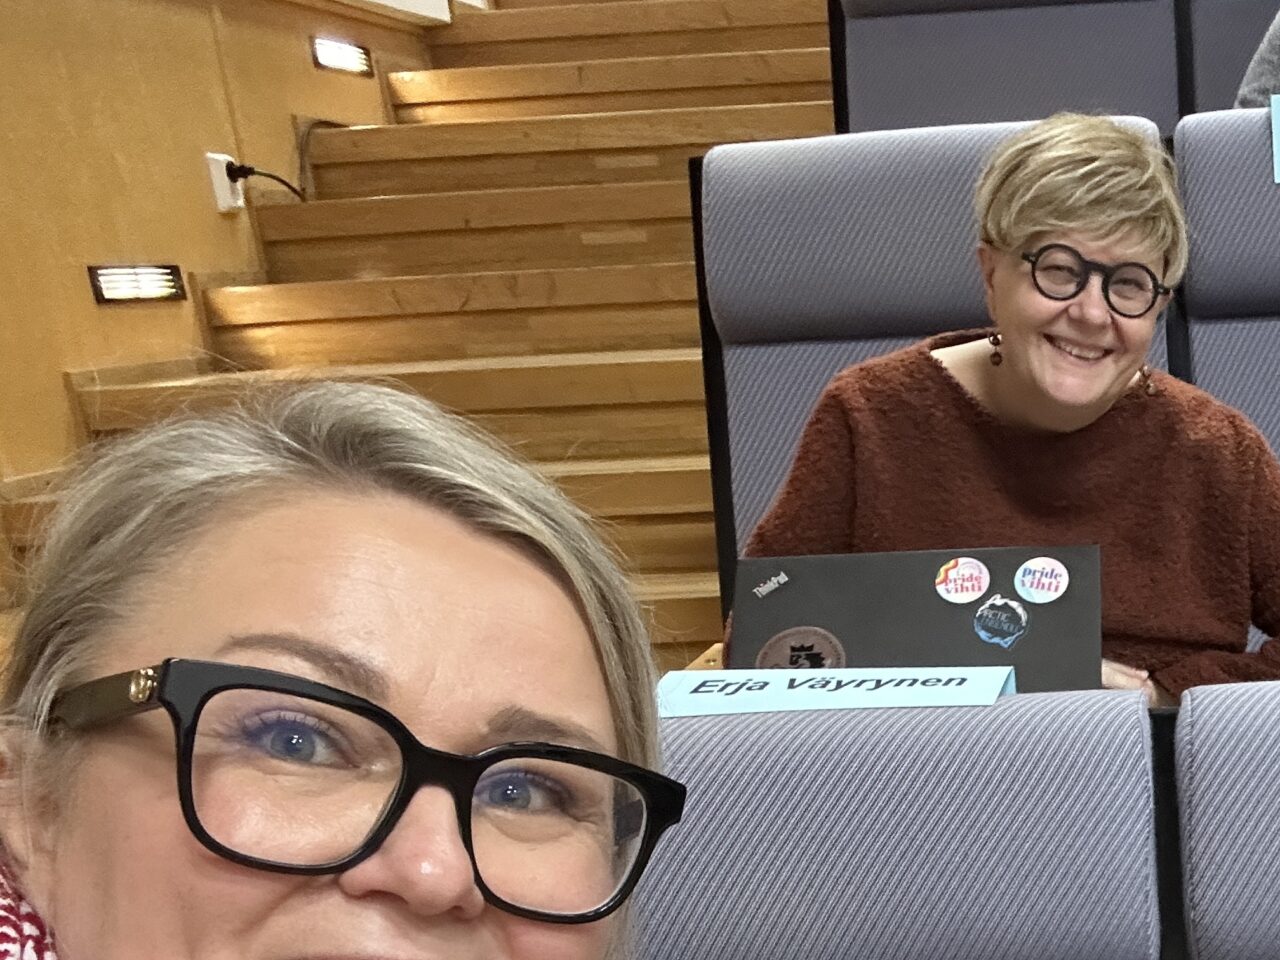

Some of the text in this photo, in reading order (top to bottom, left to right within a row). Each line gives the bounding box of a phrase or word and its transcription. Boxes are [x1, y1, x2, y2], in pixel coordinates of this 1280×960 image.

[944, 573, 982, 587] pride
[1021, 567, 1062, 581] pride
[944, 583, 983, 594] vihti
[1021, 577, 1061, 593] vihti
[689, 675, 968, 696] Erja Väyrynen
